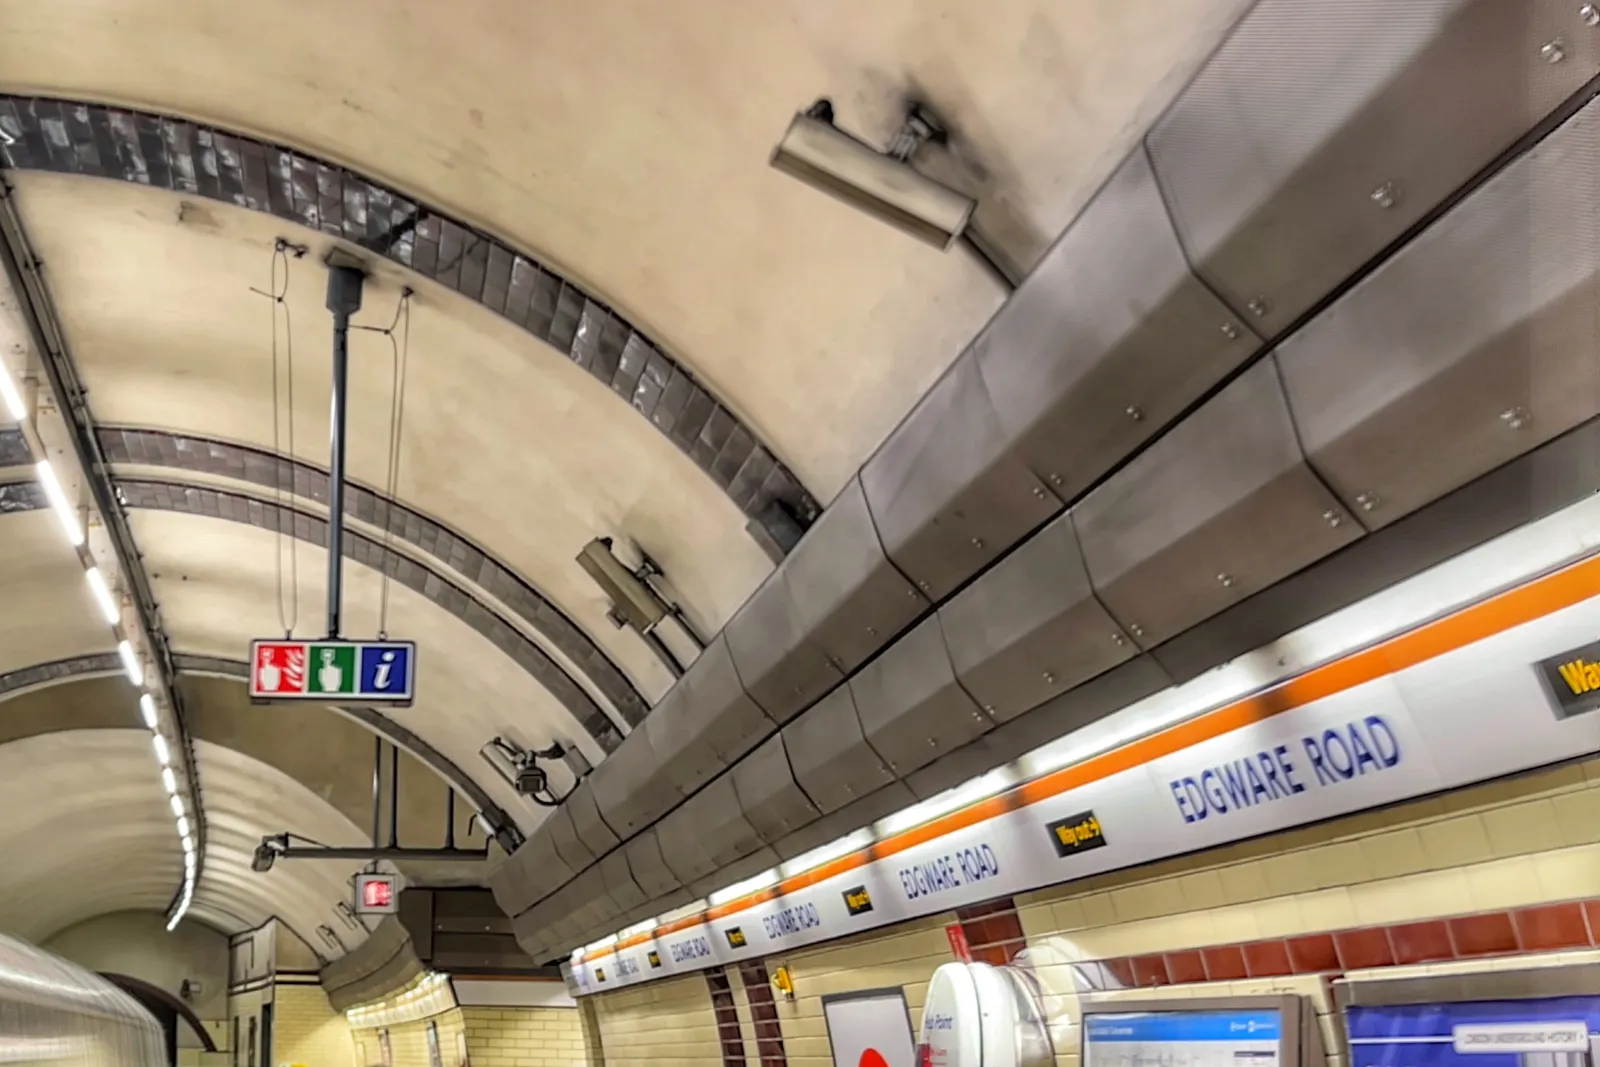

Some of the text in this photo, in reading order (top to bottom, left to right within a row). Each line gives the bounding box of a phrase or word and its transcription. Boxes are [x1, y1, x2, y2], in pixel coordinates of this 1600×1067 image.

[1557, 659, 1600, 695] Wa
[1169, 715, 1399, 824] EDGWARE ROAD
[1055, 824, 1078, 847] Way
[899, 856, 961, 899] EDGWARE
[956, 843, 999, 884] ROAD
